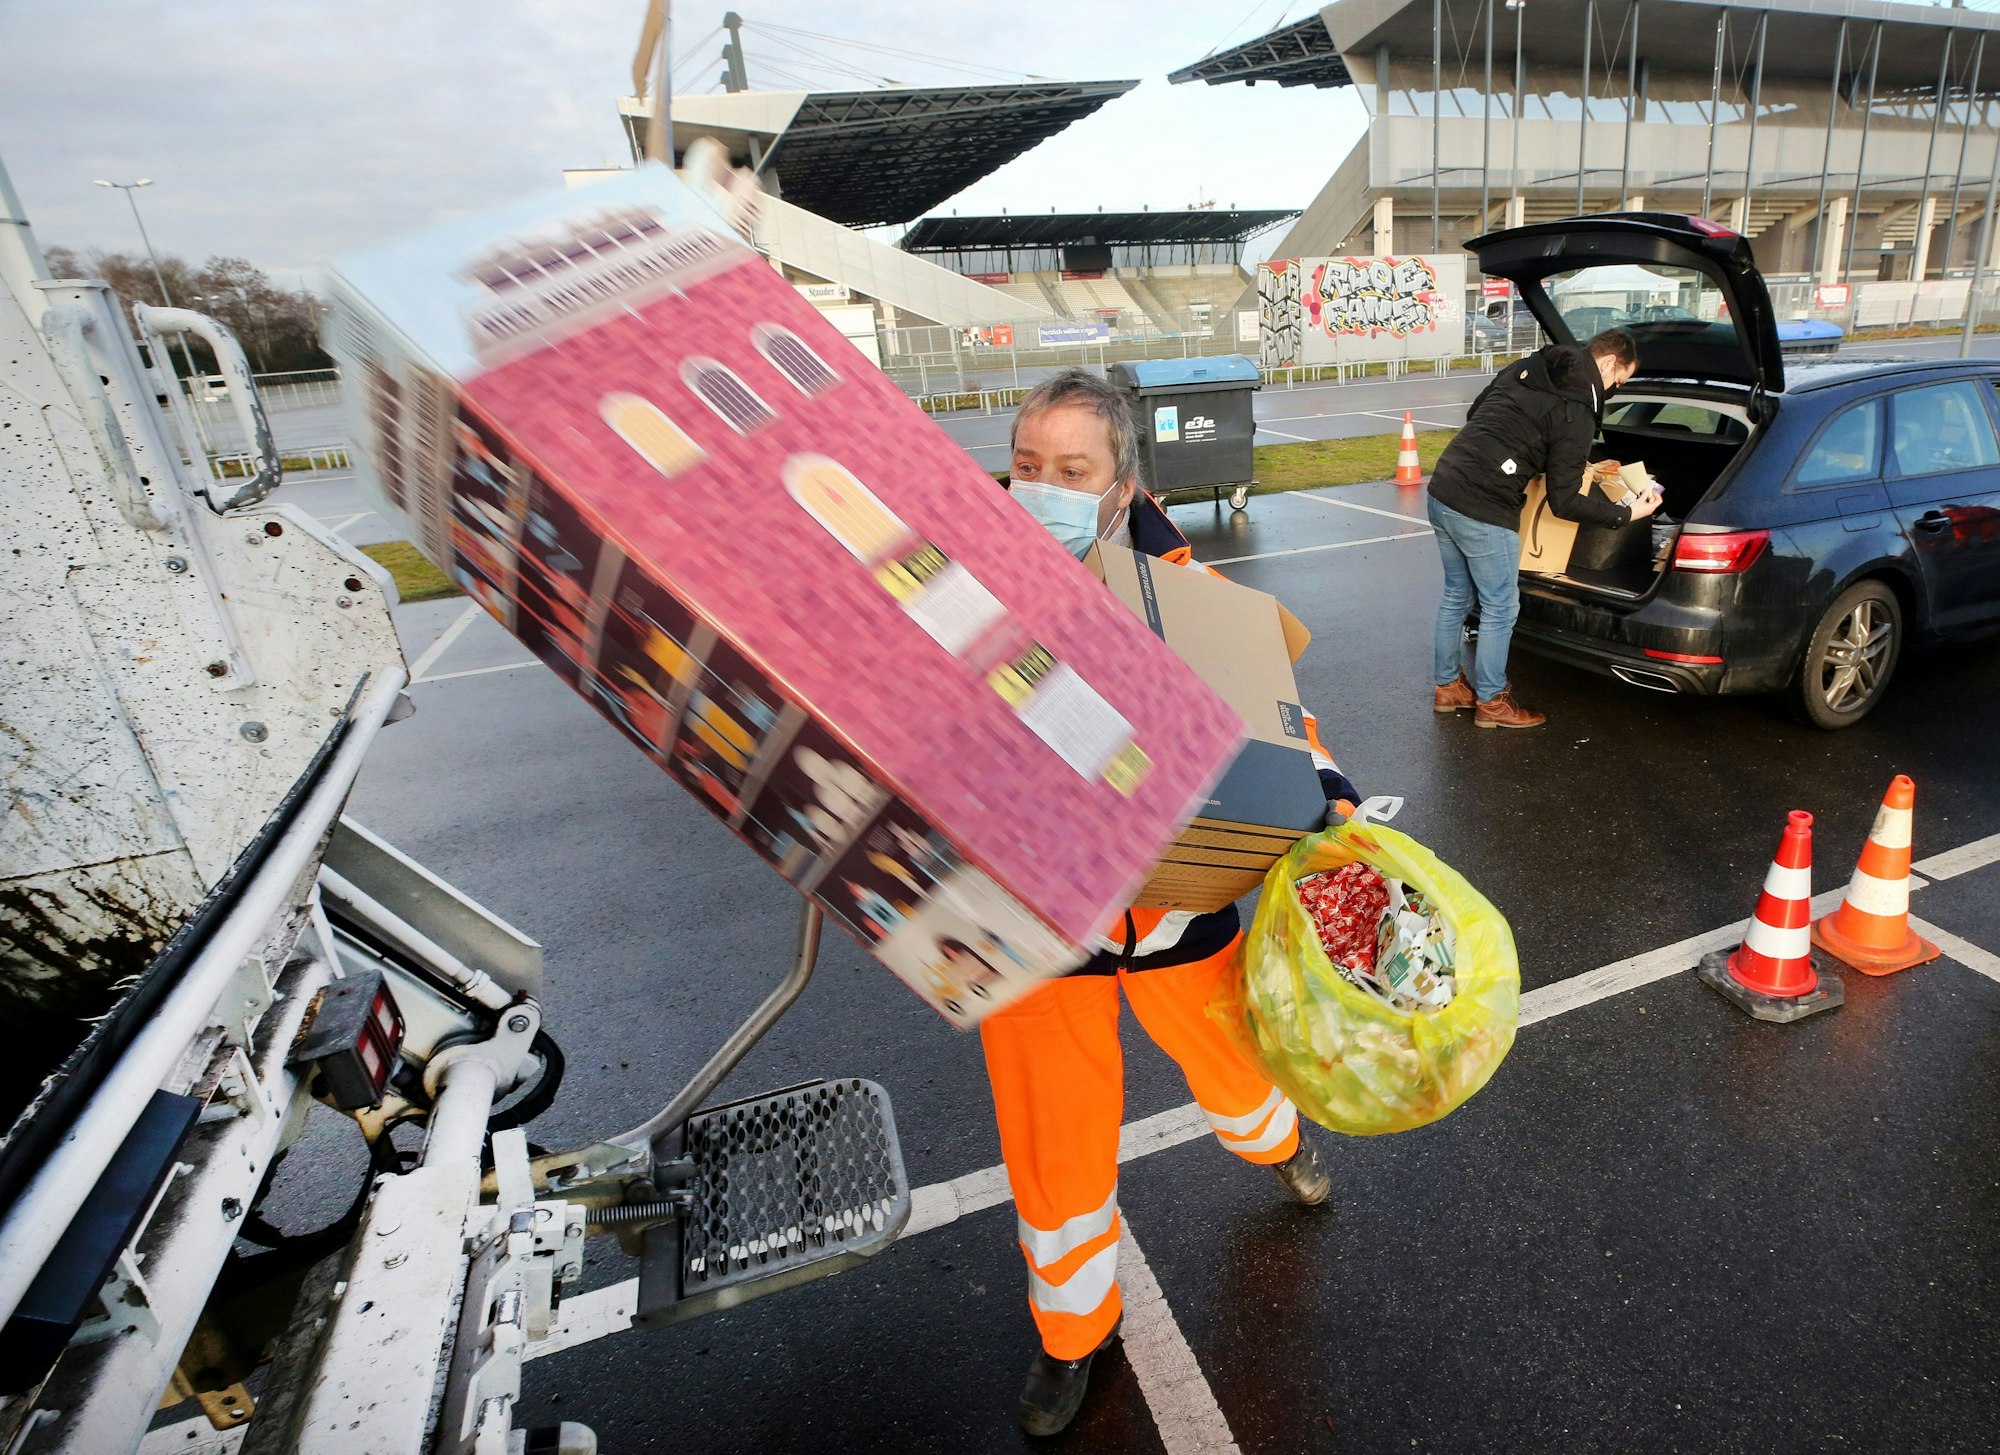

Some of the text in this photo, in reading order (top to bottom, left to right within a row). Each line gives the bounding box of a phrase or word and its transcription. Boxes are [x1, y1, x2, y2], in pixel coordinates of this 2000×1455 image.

[808, 286, 835, 297] Stauder
[1040, 328, 1063, 336] Herzlich
[1138, 561, 1153, 601] FOOTWEAR
